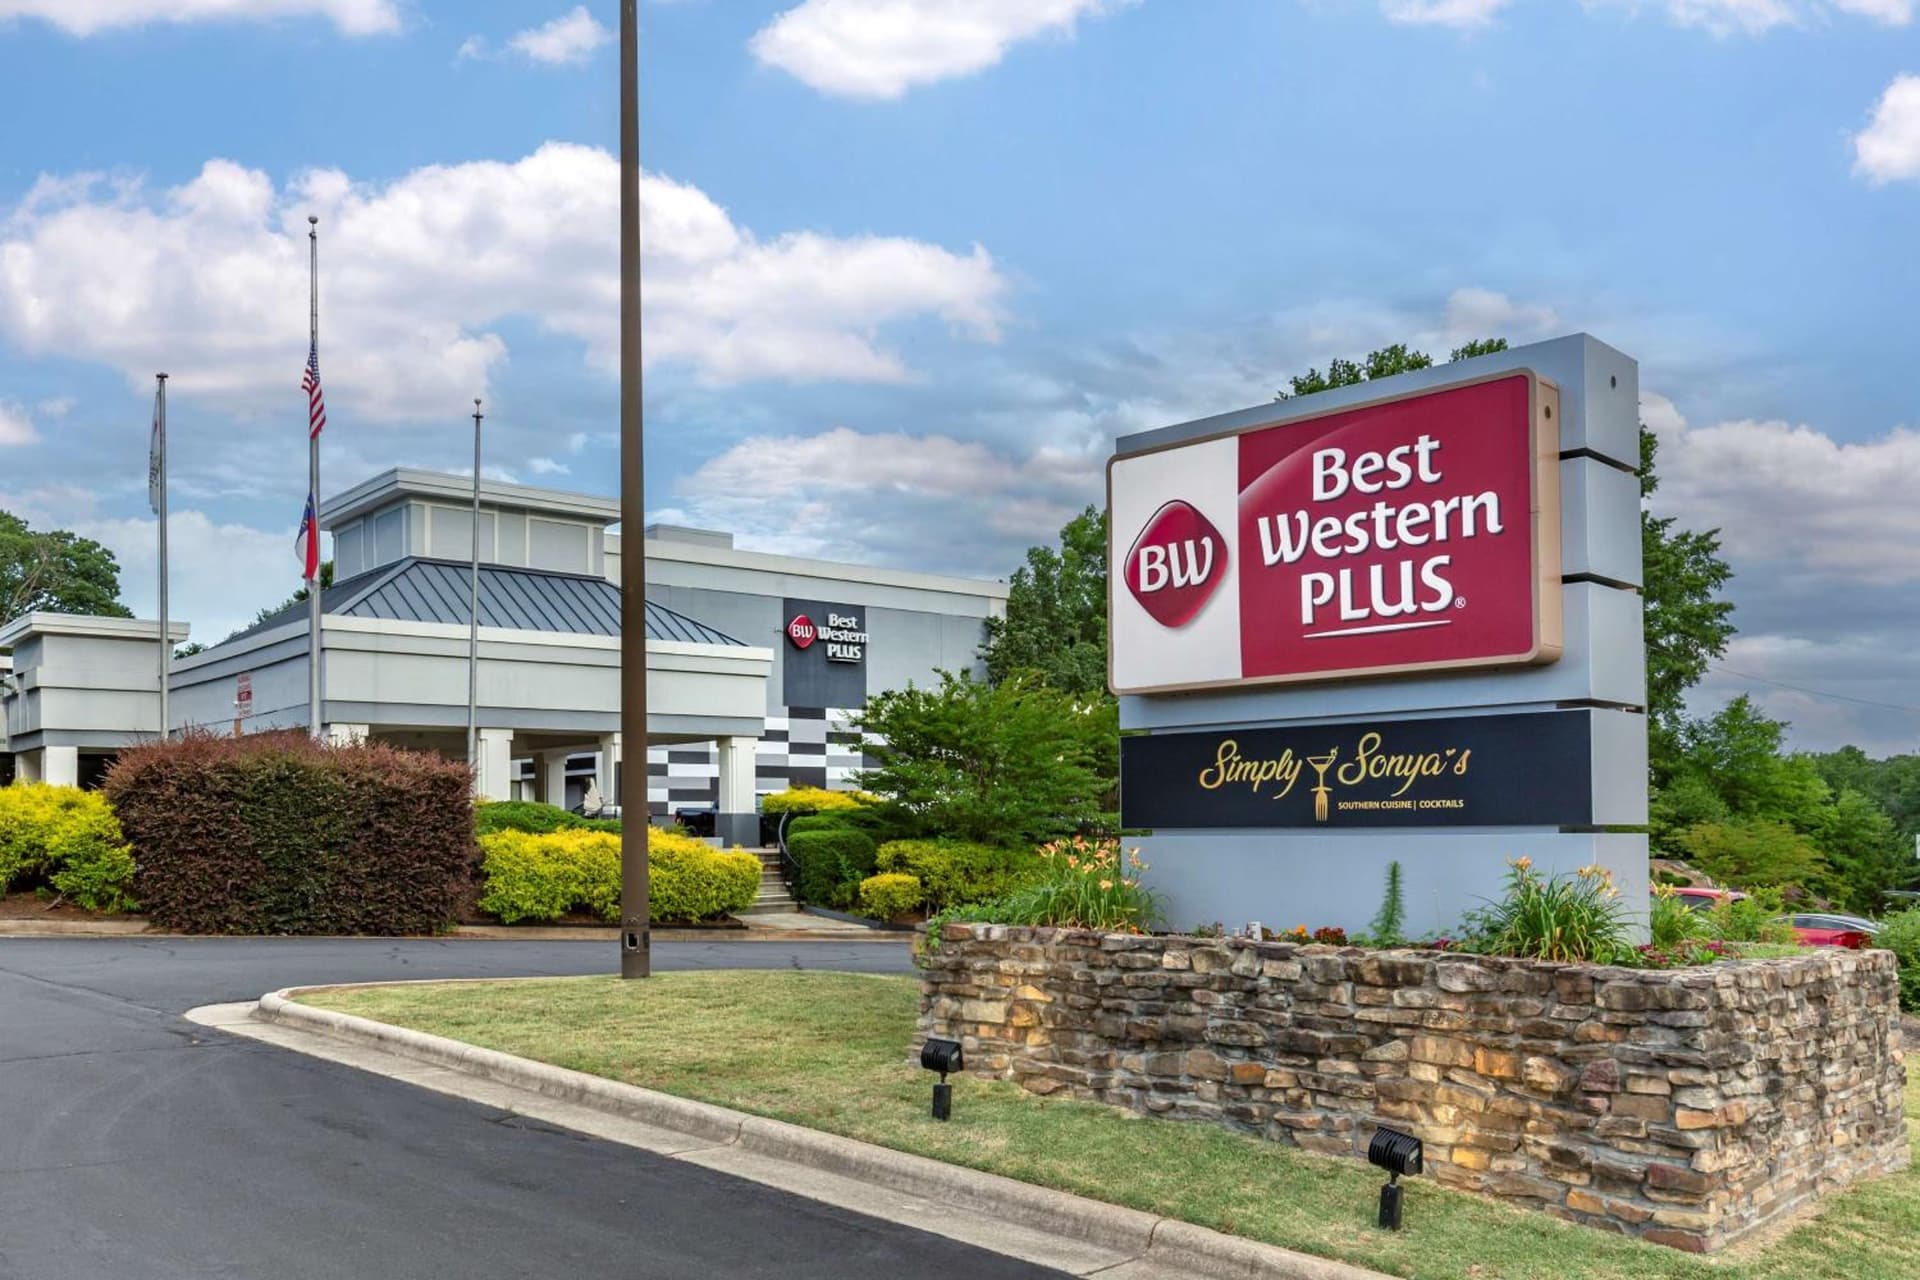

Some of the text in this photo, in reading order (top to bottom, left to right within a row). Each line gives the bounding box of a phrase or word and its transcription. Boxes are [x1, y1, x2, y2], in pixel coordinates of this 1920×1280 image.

[1312, 434, 1442, 502] Best
[1257, 490, 1504, 567] Western
[1138, 536, 1213, 593] BW
[828, 613, 858, 629] Best
[792, 624, 813, 638] BW
[817, 626, 870, 643] Western
[827, 643, 862, 659] PLUS
[1199, 731, 1472, 800] Simply Sonya's
[1338, 800, 1380, 810] SOUTHERN
[1380, 800, 1413, 810] CUISINE
[1419, 799, 1464, 809] COCKTAILS
